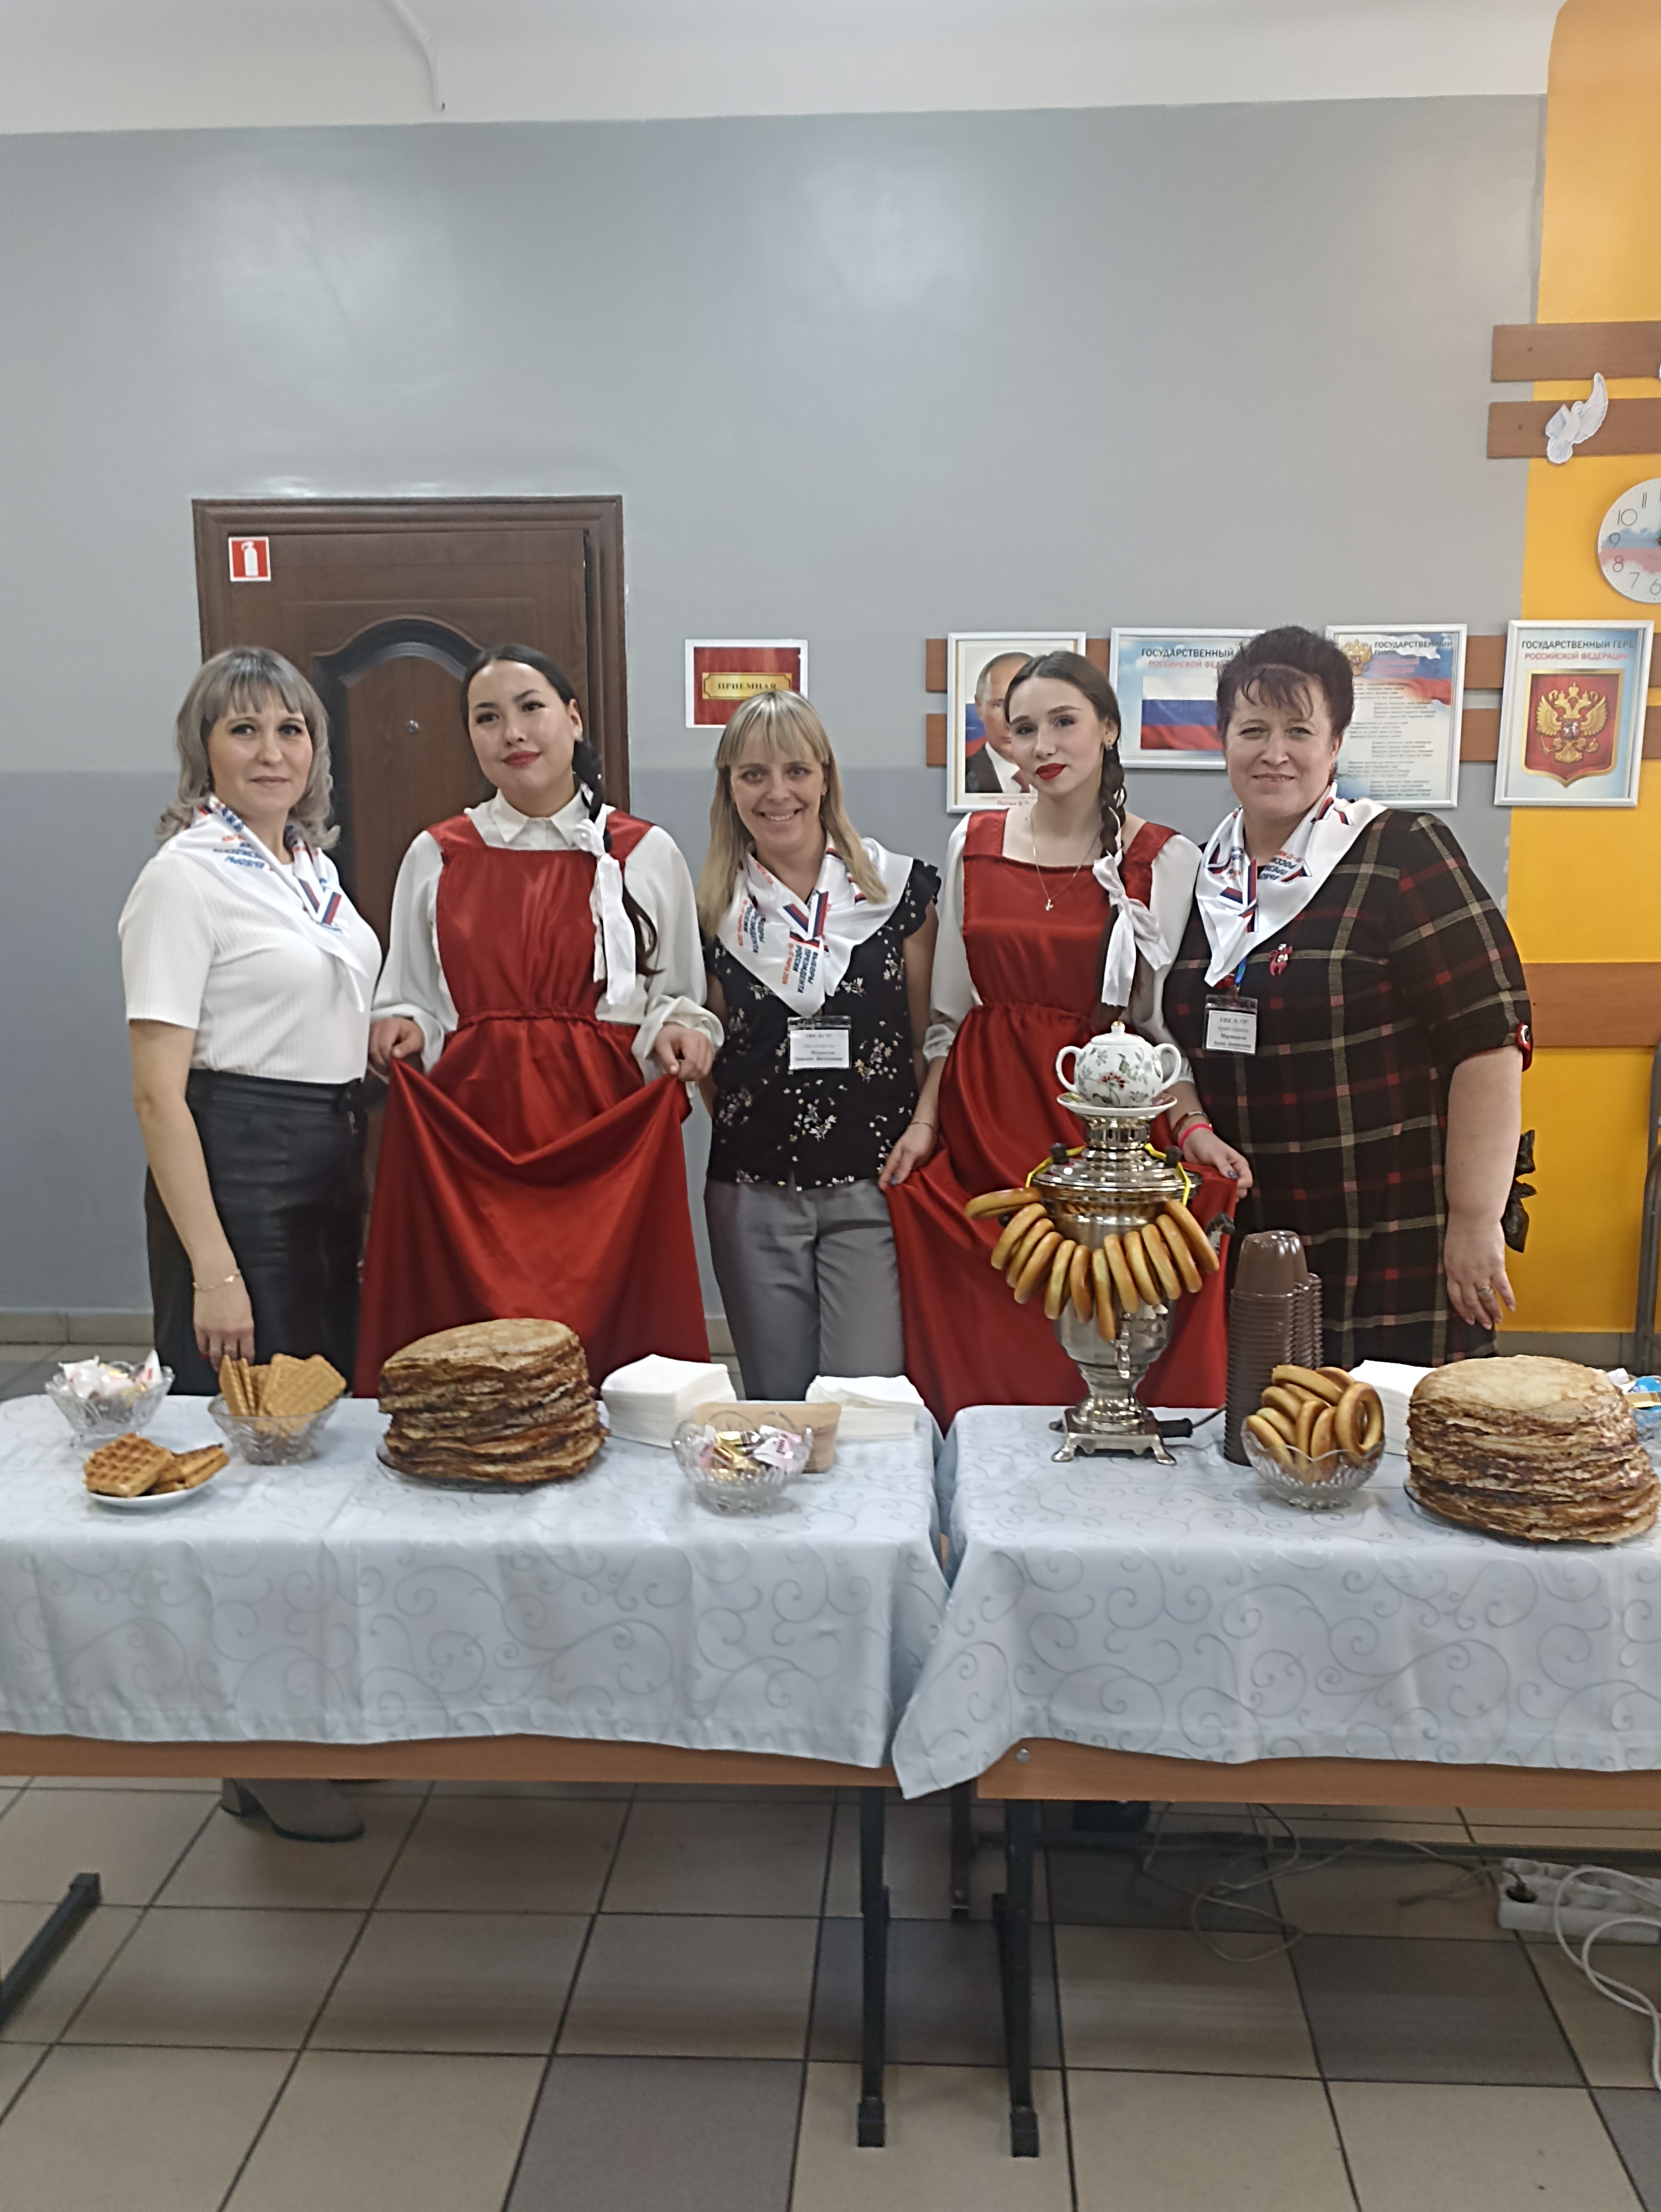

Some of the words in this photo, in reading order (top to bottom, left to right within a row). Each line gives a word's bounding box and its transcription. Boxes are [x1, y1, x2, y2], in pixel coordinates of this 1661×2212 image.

[1641, 492, 1648, 509] 11
[1617, 508, 1638, 526] 10
[1609, 532, 1621, 549] 9
[1612, 555, 1624, 573] 8
[1628, 572, 1640, 589] 7
[1650, 578, 1661, 595] 6
[1141, 647, 1234, 658] ГОСУДАРСТВЕННЫЙ
[1521, 640, 1610, 649] ГОСУДАРСТВЕННЫЙ
[1613, 640, 1635, 648] ГЕРБ
[1149, 659, 1202, 668] РОССИЙСКОЙ
[1525, 651, 1579, 660] РОССИЙСКОЙ
[1581, 652, 1630, 661] ФЕДЕРАЦИИ
[792, 944, 802, 972] РОССИИ
[807, 951, 819, 984] ВЫБОРЫ
